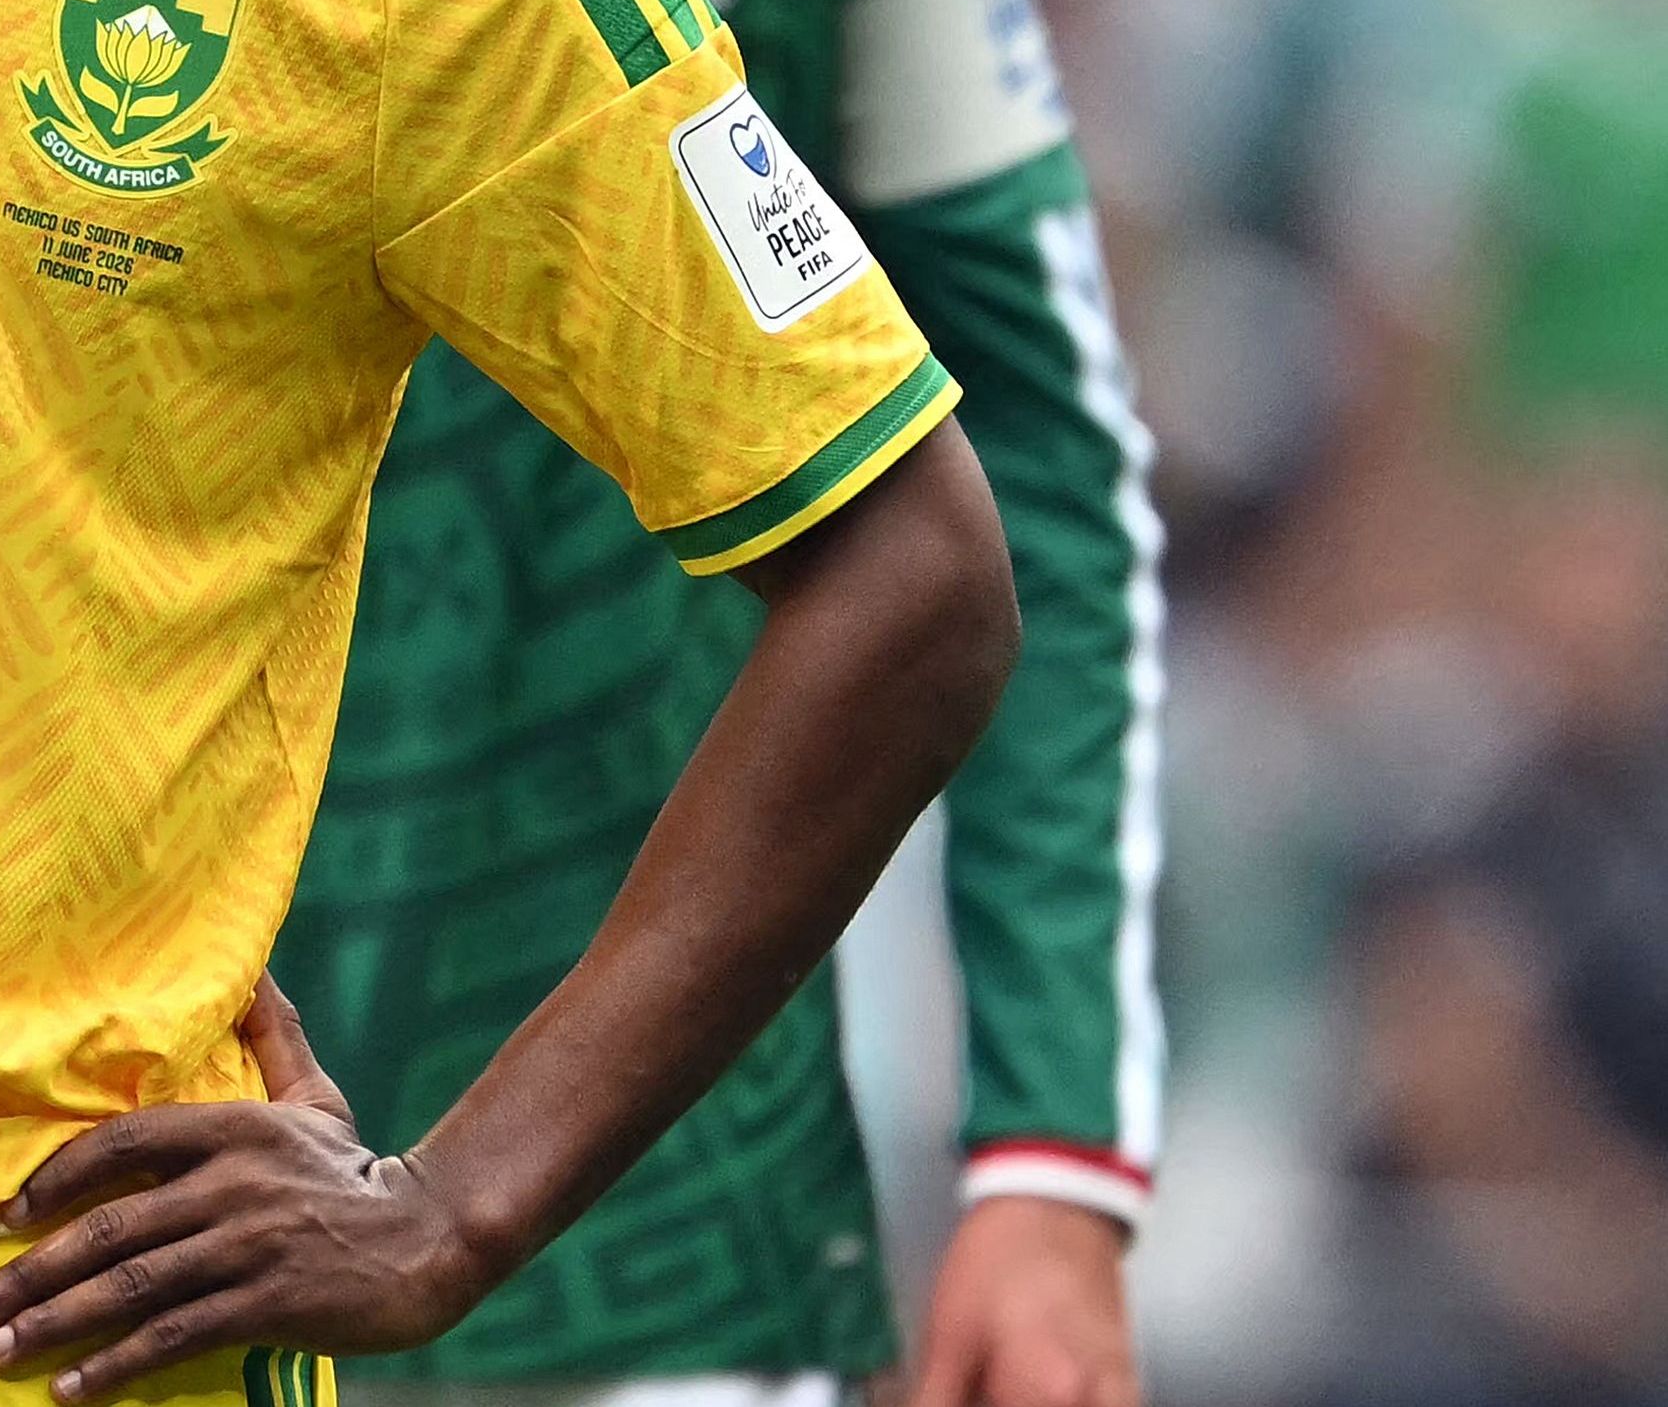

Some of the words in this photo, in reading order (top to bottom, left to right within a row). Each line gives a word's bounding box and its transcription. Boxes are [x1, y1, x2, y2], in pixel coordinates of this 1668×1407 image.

[41, 131, 103, 180] SOUTH
[104, 165, 181, 188] AFRICA
[2, 201, 58, 232] MEXICO
[84, 223, 131, 250] SOUTH
[133, 235, 185, 264] AFRICA
[42, 235, 55, 254] 11
[56, 238, 92, 264] JUNE
[96, 249, 135, 275] 2026
[766, 203, 830, 267] PEACE
[36, 257, 95, 288] MEXICO
[96, 273, 129, 296] CITY
[797, 250, 833, 282] FIFA
